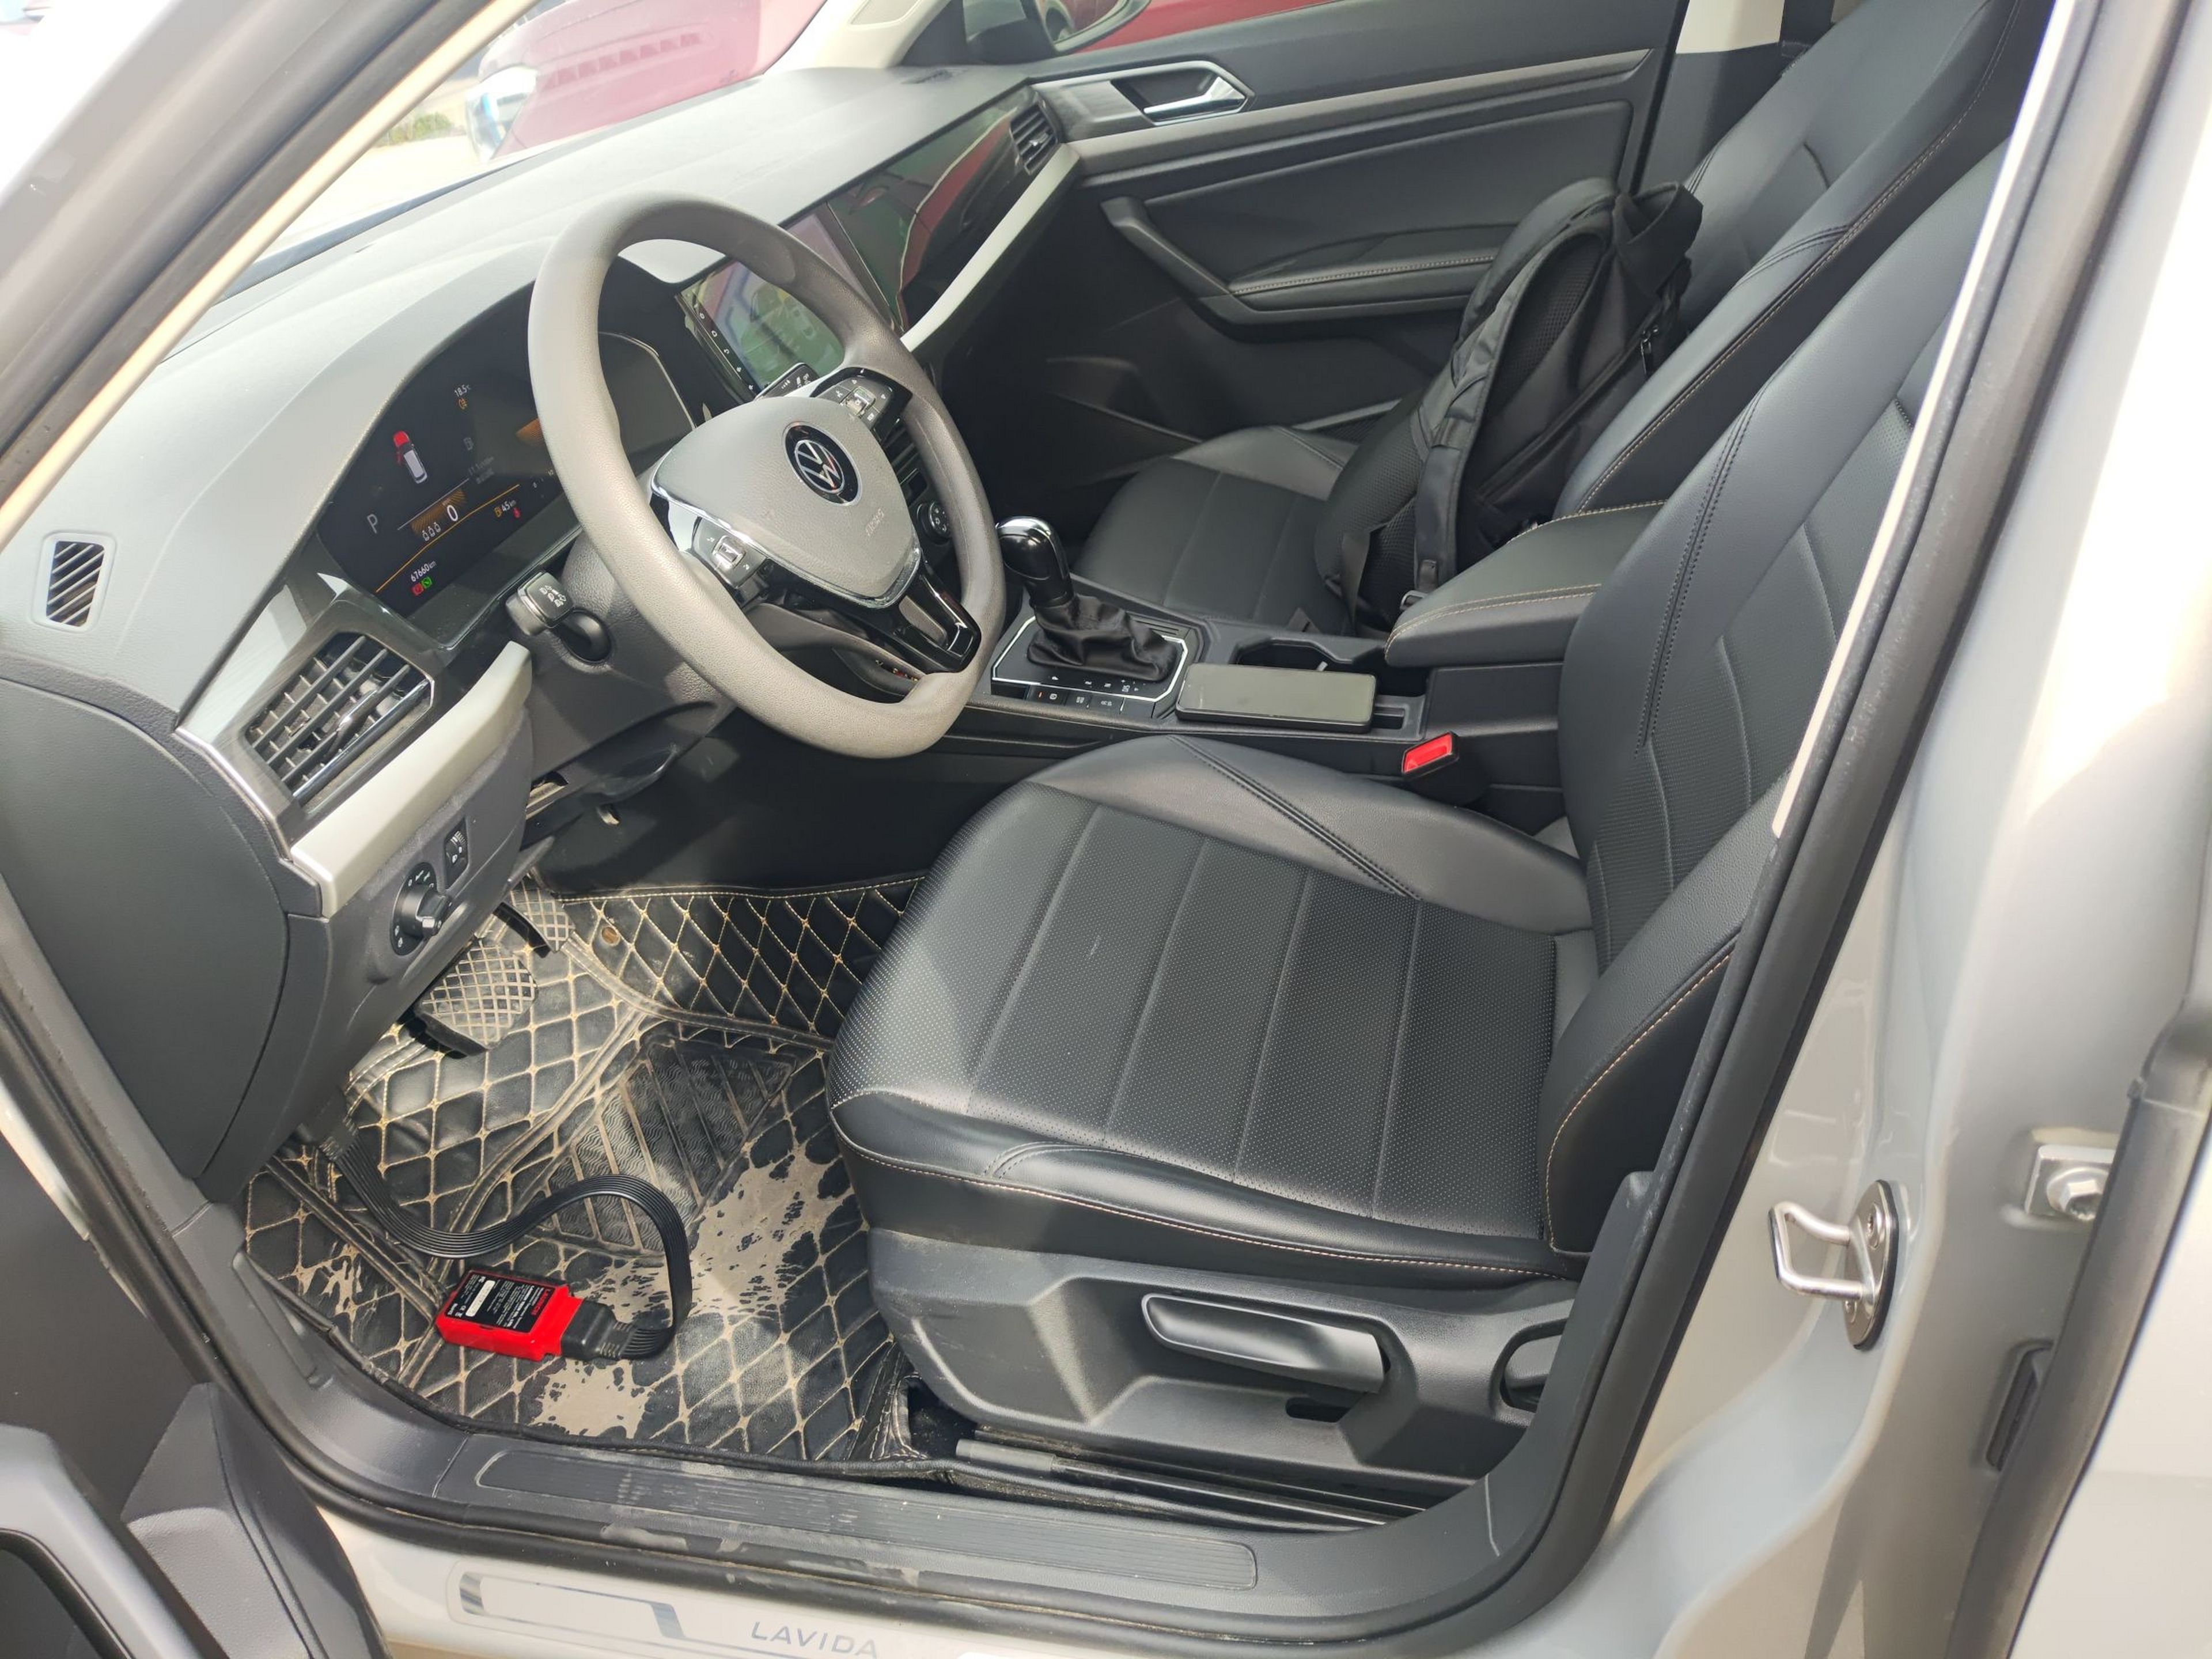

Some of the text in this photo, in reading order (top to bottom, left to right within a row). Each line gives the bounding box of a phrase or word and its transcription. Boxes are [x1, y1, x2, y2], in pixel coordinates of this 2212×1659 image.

[446, 504, 459, 522] 0
[367, 514, 377, 534] P
[751, 1622, 877, 1659] LAVIDA
